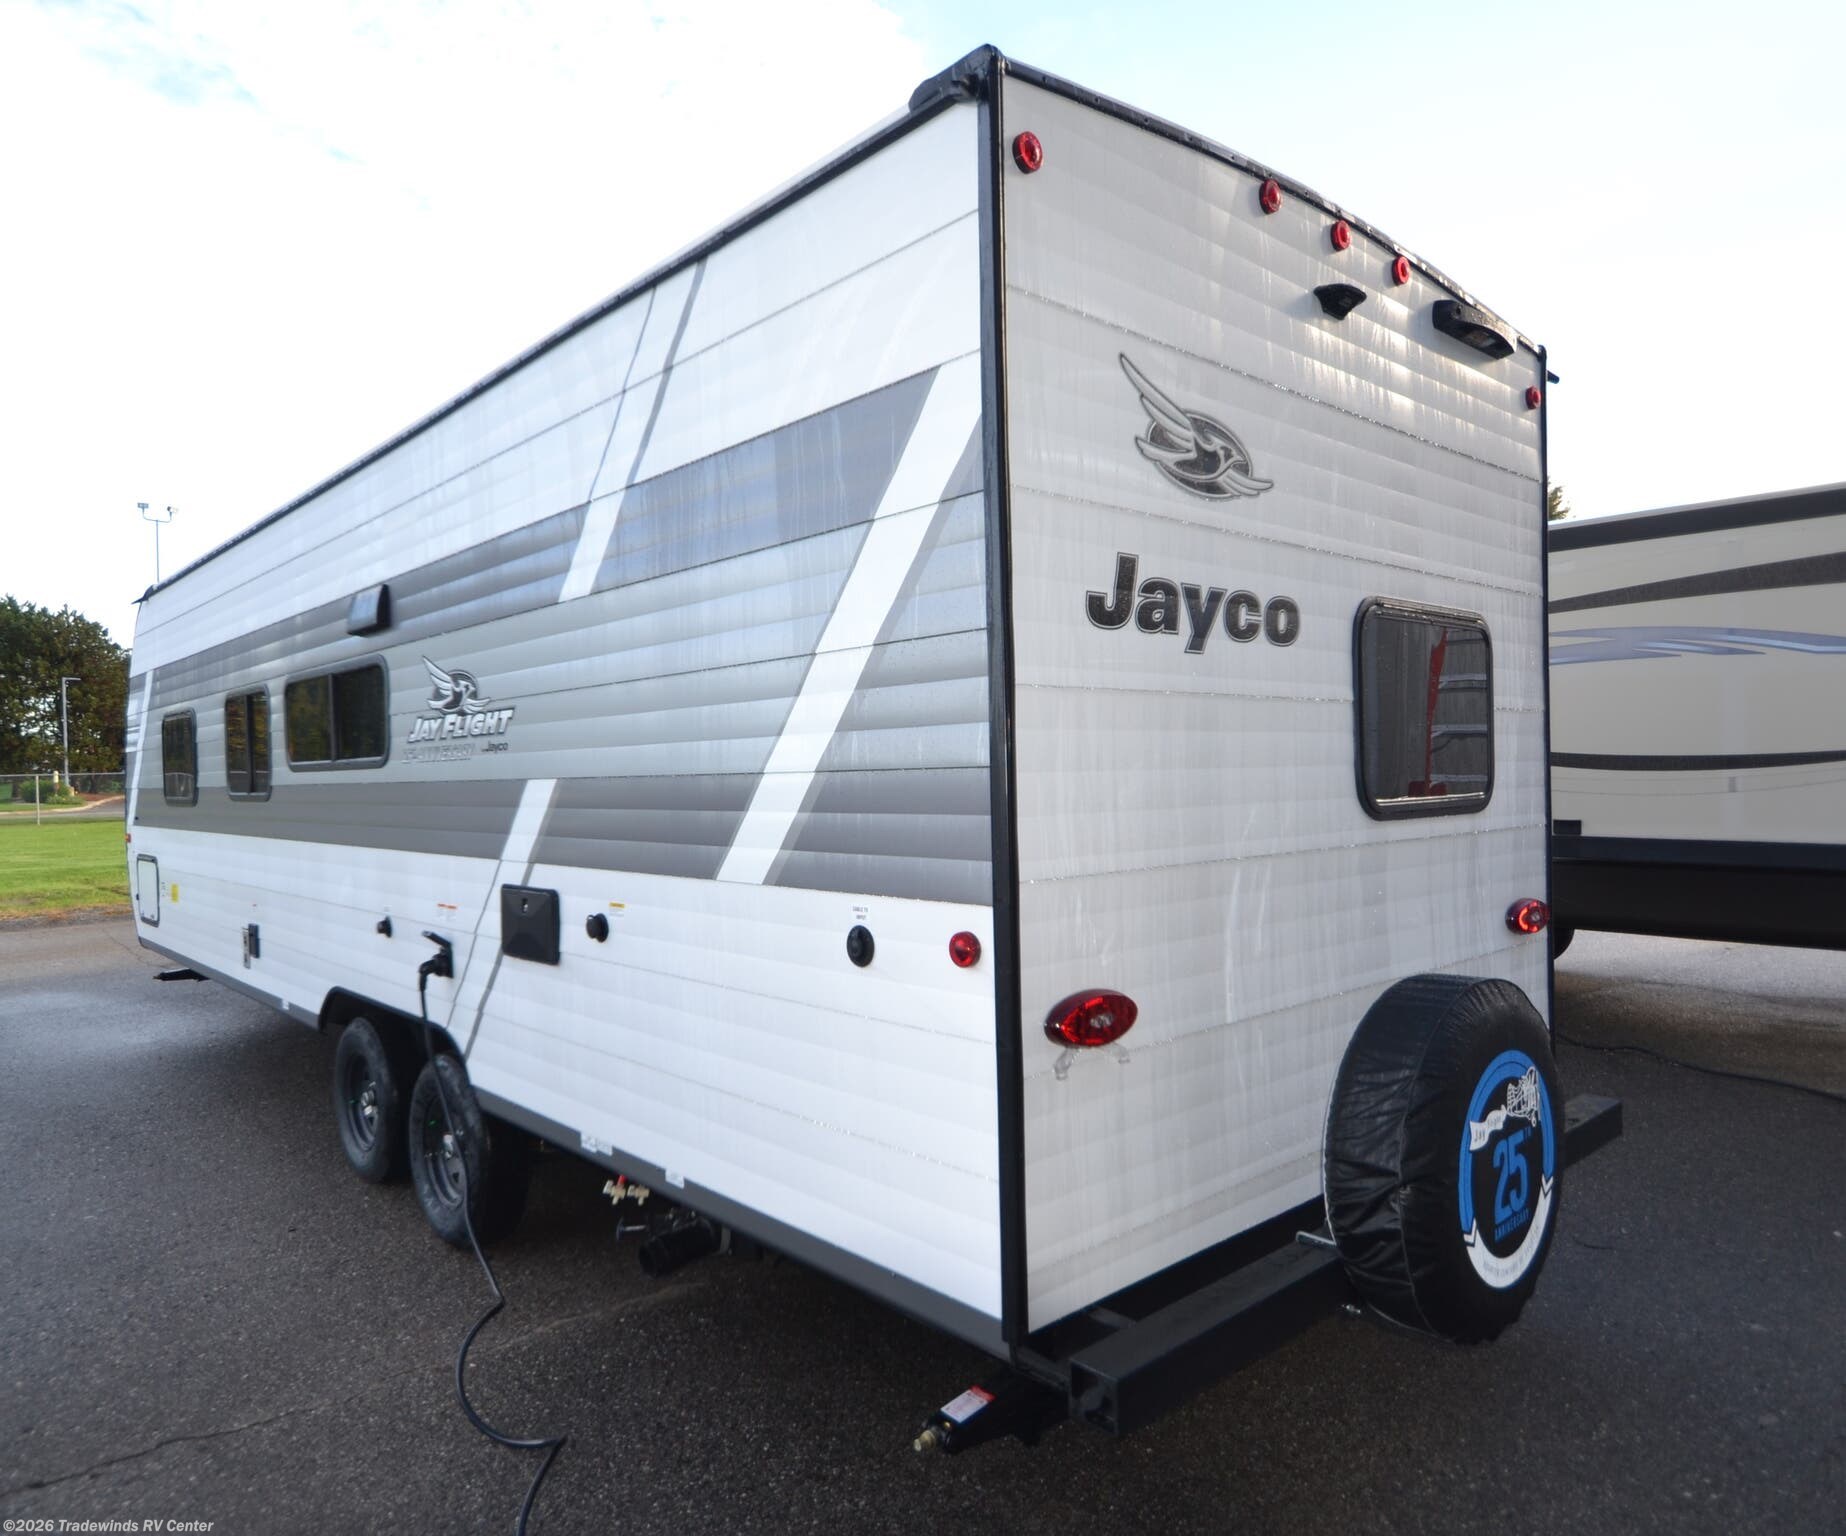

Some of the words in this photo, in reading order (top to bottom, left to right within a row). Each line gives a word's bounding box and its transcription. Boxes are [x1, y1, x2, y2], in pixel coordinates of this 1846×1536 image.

[1086, 552, 1301, 654] Jayco
[407, 716, 444, 743] JAY
[440, 706, 516, 739] FLIGHT
